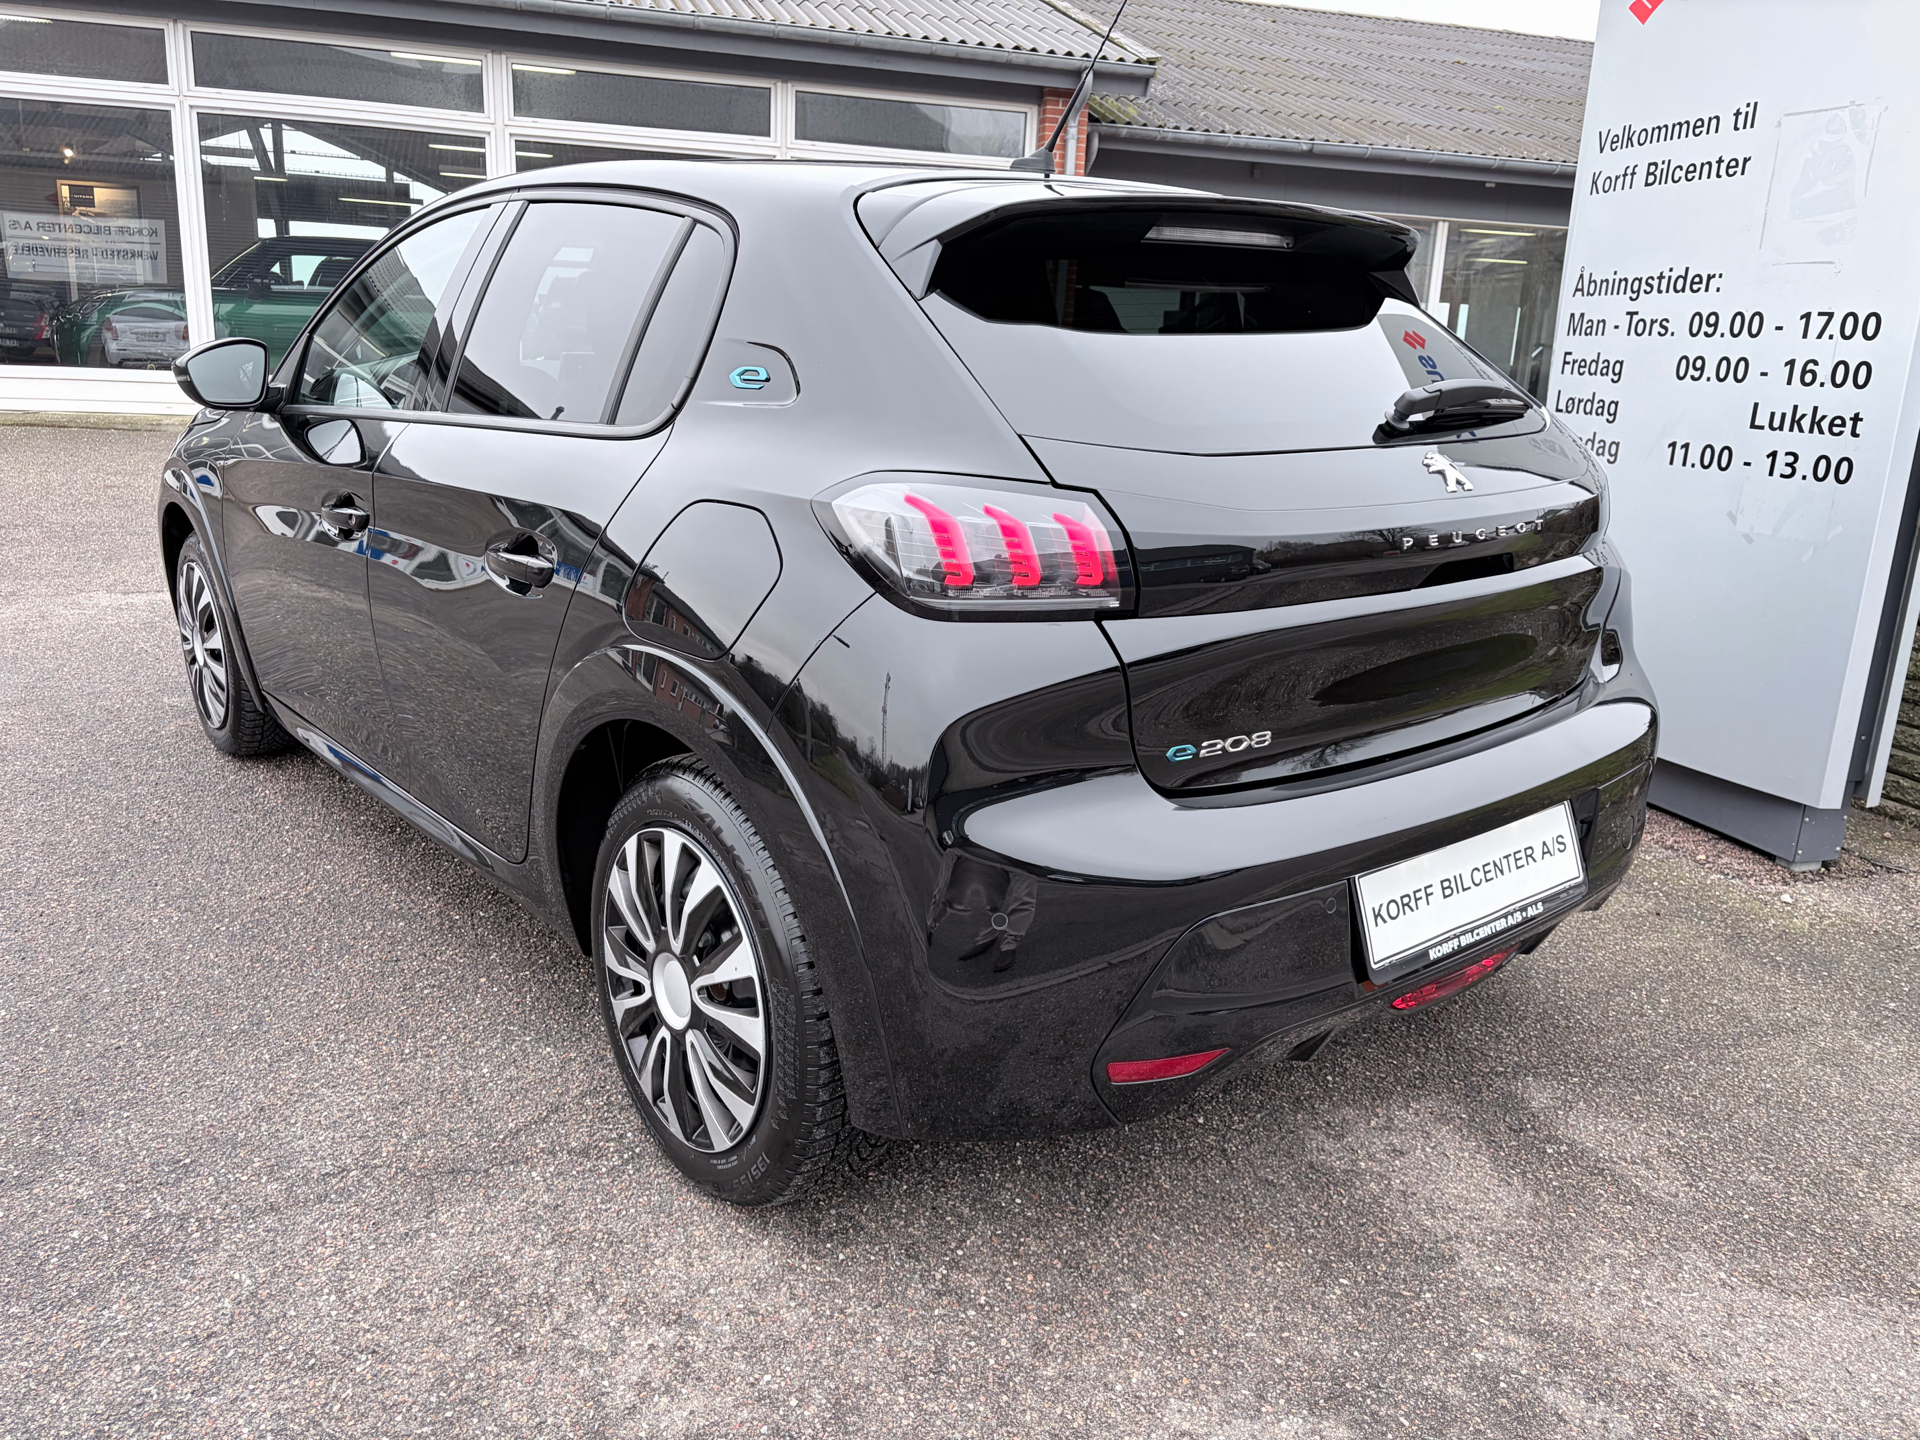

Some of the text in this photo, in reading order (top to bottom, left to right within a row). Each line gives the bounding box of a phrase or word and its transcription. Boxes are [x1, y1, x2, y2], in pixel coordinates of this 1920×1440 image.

[1598, 101, 1759, 154] Velkommen til
[1589, 154, 1752, 196] Korff Bilcenter
[1572, 265, 1723, 302] Åbningstider:
[1566, 310, 1883, 342] Man - Tors. 09.00 - 17.00
[1560, 351, 1873, 390] Fredag 09.00 - 16.00
[1555, 389, 1864, 439] Lørdag Lukket
[1579, 431, 1855, 486] dag 11.00 - 13.00
[1402, 519, 1544, 551] PEUGEOT
[1165, 730, 1272, 763] e208
[1371, 834, 1568, 928] KORFF BILCENTER A/S
[1428, 902, 1544, 961] KORFF BILCENTER A/S ALS
